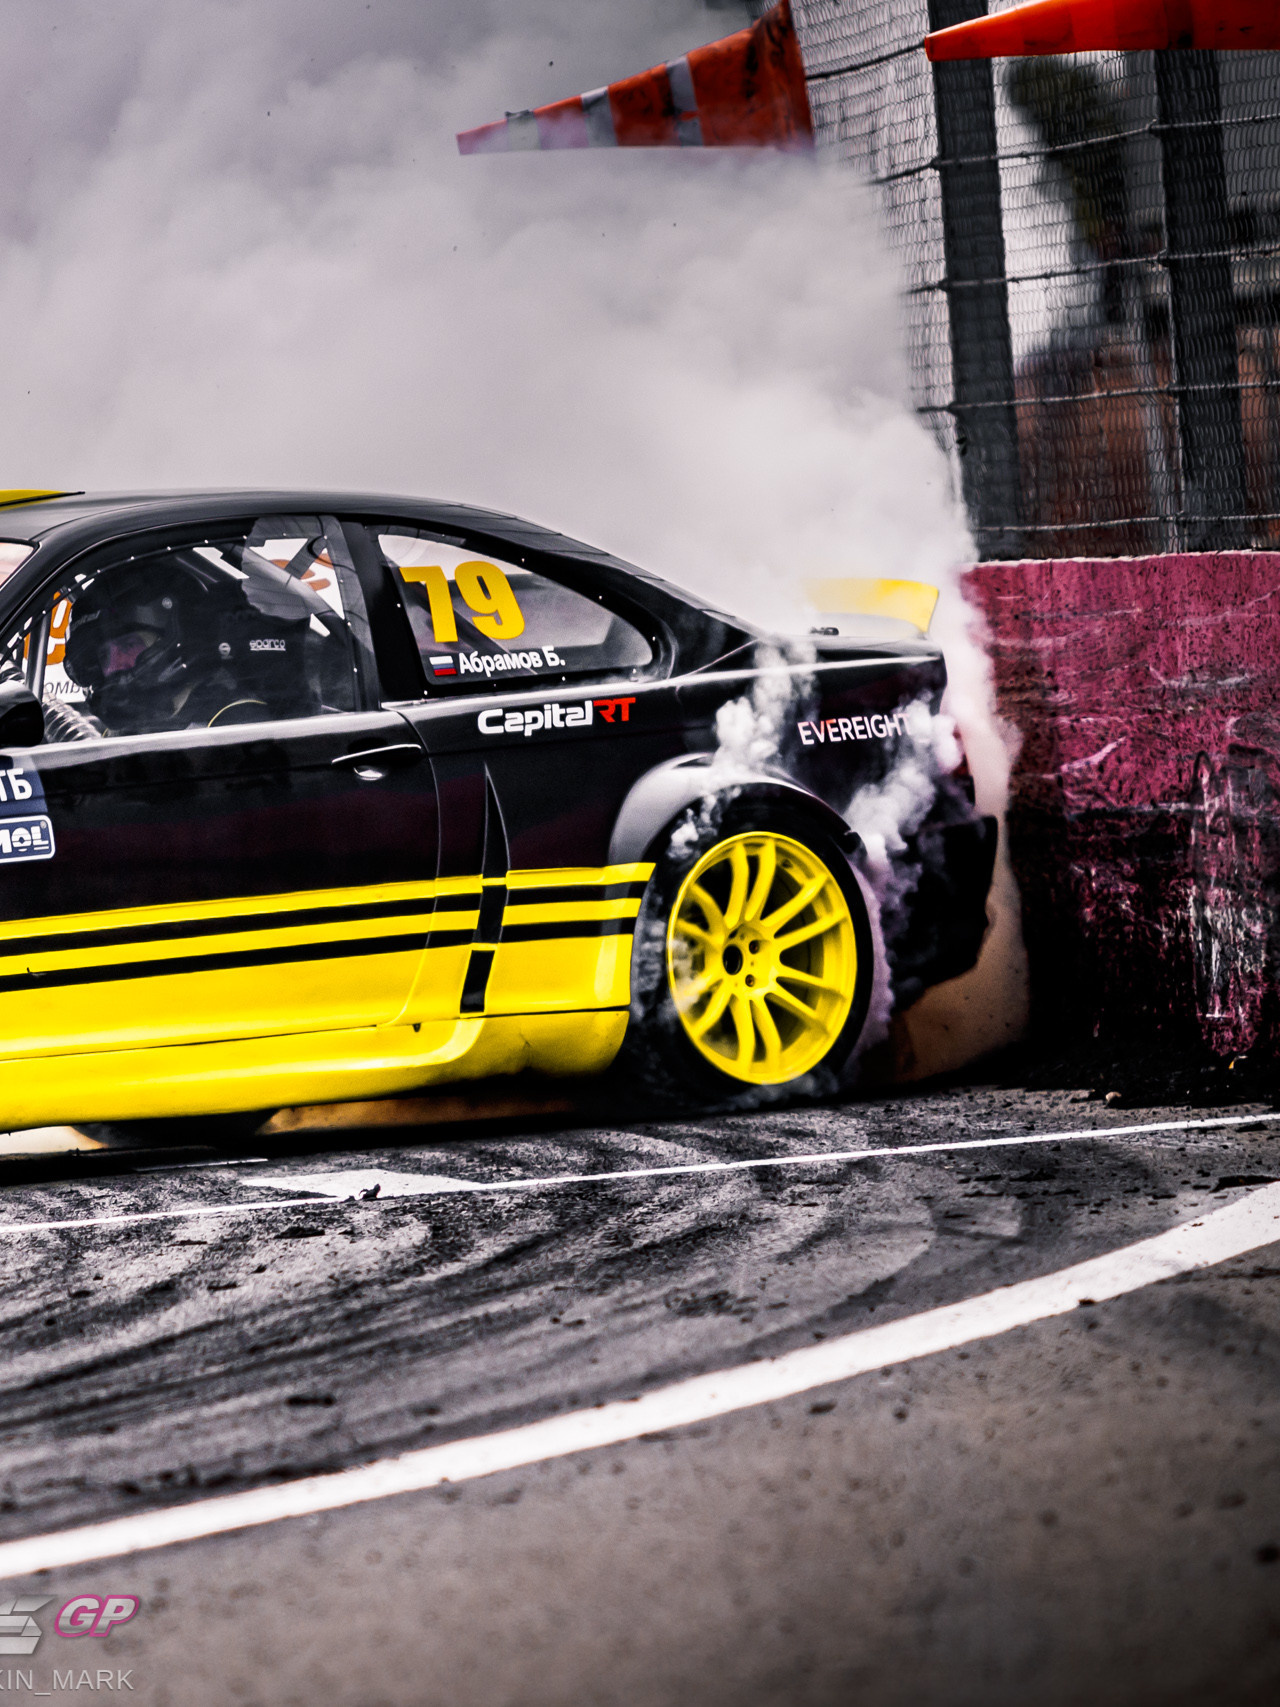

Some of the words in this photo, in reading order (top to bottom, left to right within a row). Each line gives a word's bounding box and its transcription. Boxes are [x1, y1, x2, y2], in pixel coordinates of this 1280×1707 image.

[399, 561, 525, 642] 79
[458, 650, 543, 677] Абрамов
[542, 645, 566, 667] Б.
